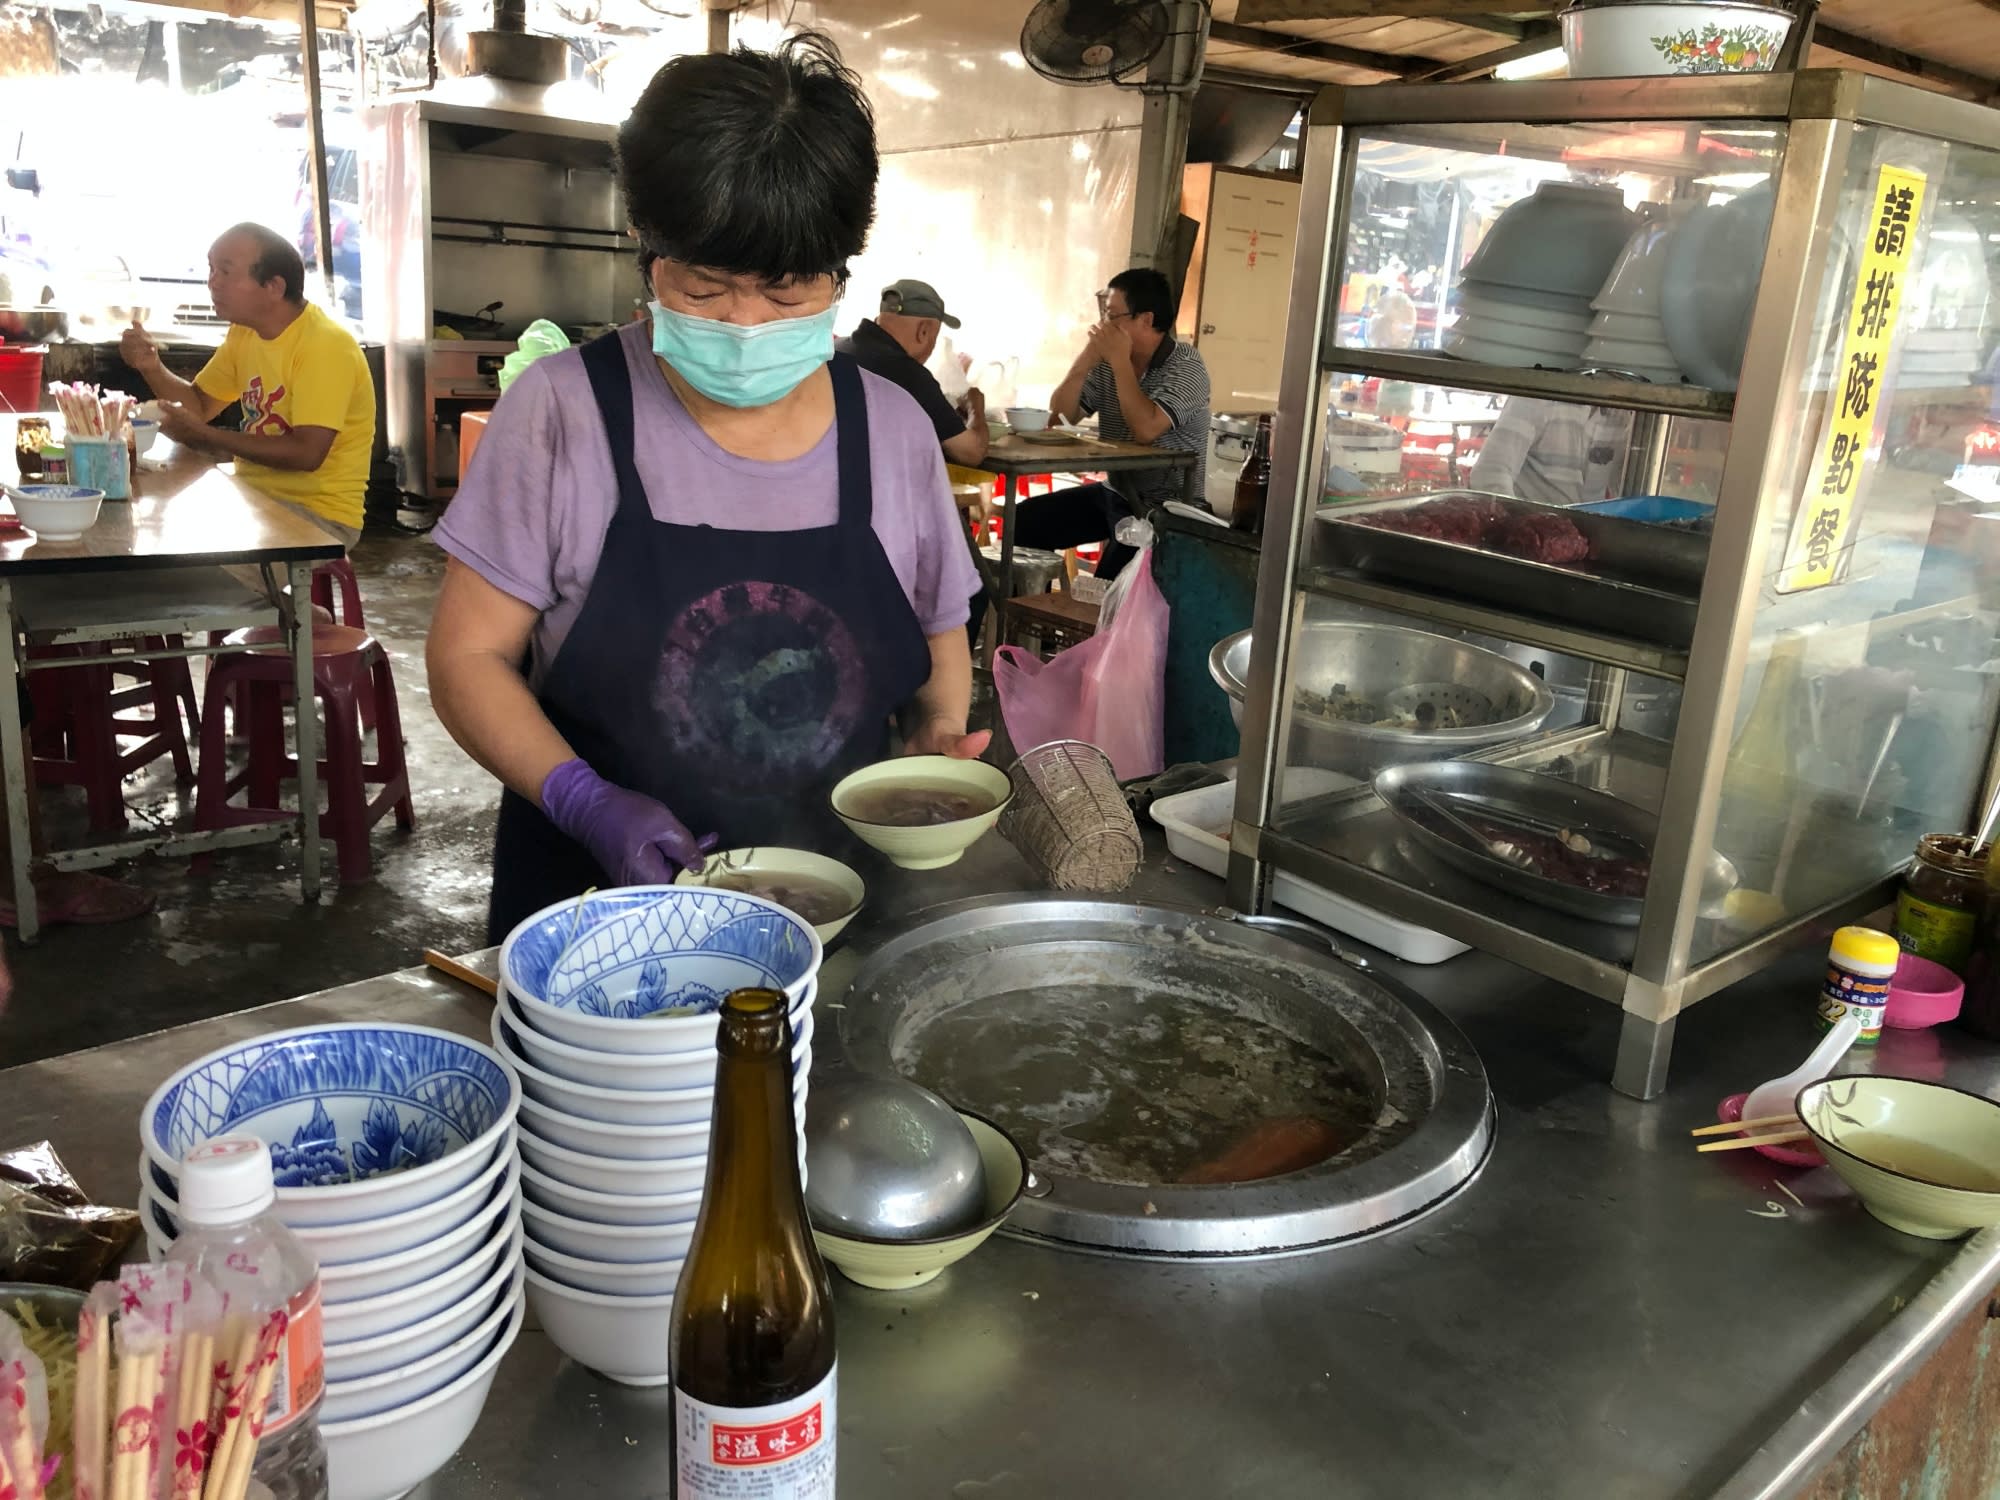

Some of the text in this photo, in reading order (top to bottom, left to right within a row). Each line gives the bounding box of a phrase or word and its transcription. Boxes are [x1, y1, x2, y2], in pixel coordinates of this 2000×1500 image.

[1805, 184, 1915, 572] 請排隊點餐
